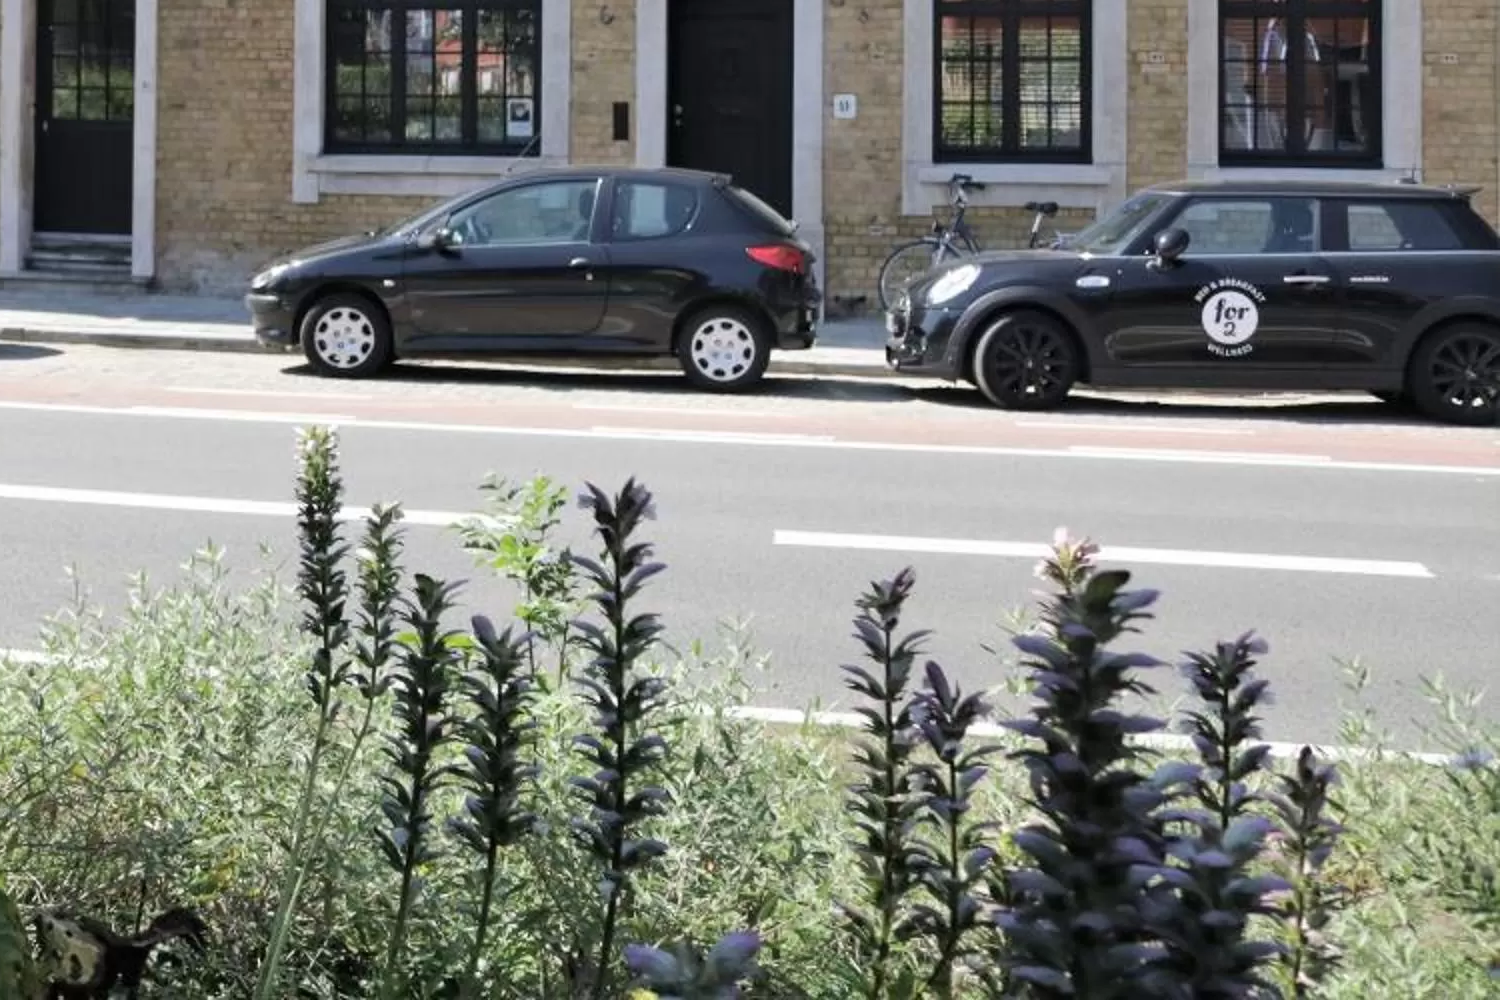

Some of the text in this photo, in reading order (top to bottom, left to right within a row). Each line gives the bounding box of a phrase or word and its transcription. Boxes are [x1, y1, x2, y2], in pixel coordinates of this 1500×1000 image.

[1194, 286, 1210, 302] BED
[1218, 277, 1266, 302] BREAKFAST
[1214, 298, 1250, 324] for
[1223, 321, 1236, 337] 2
[1207, 343, 1253, 357] WELLNESS
